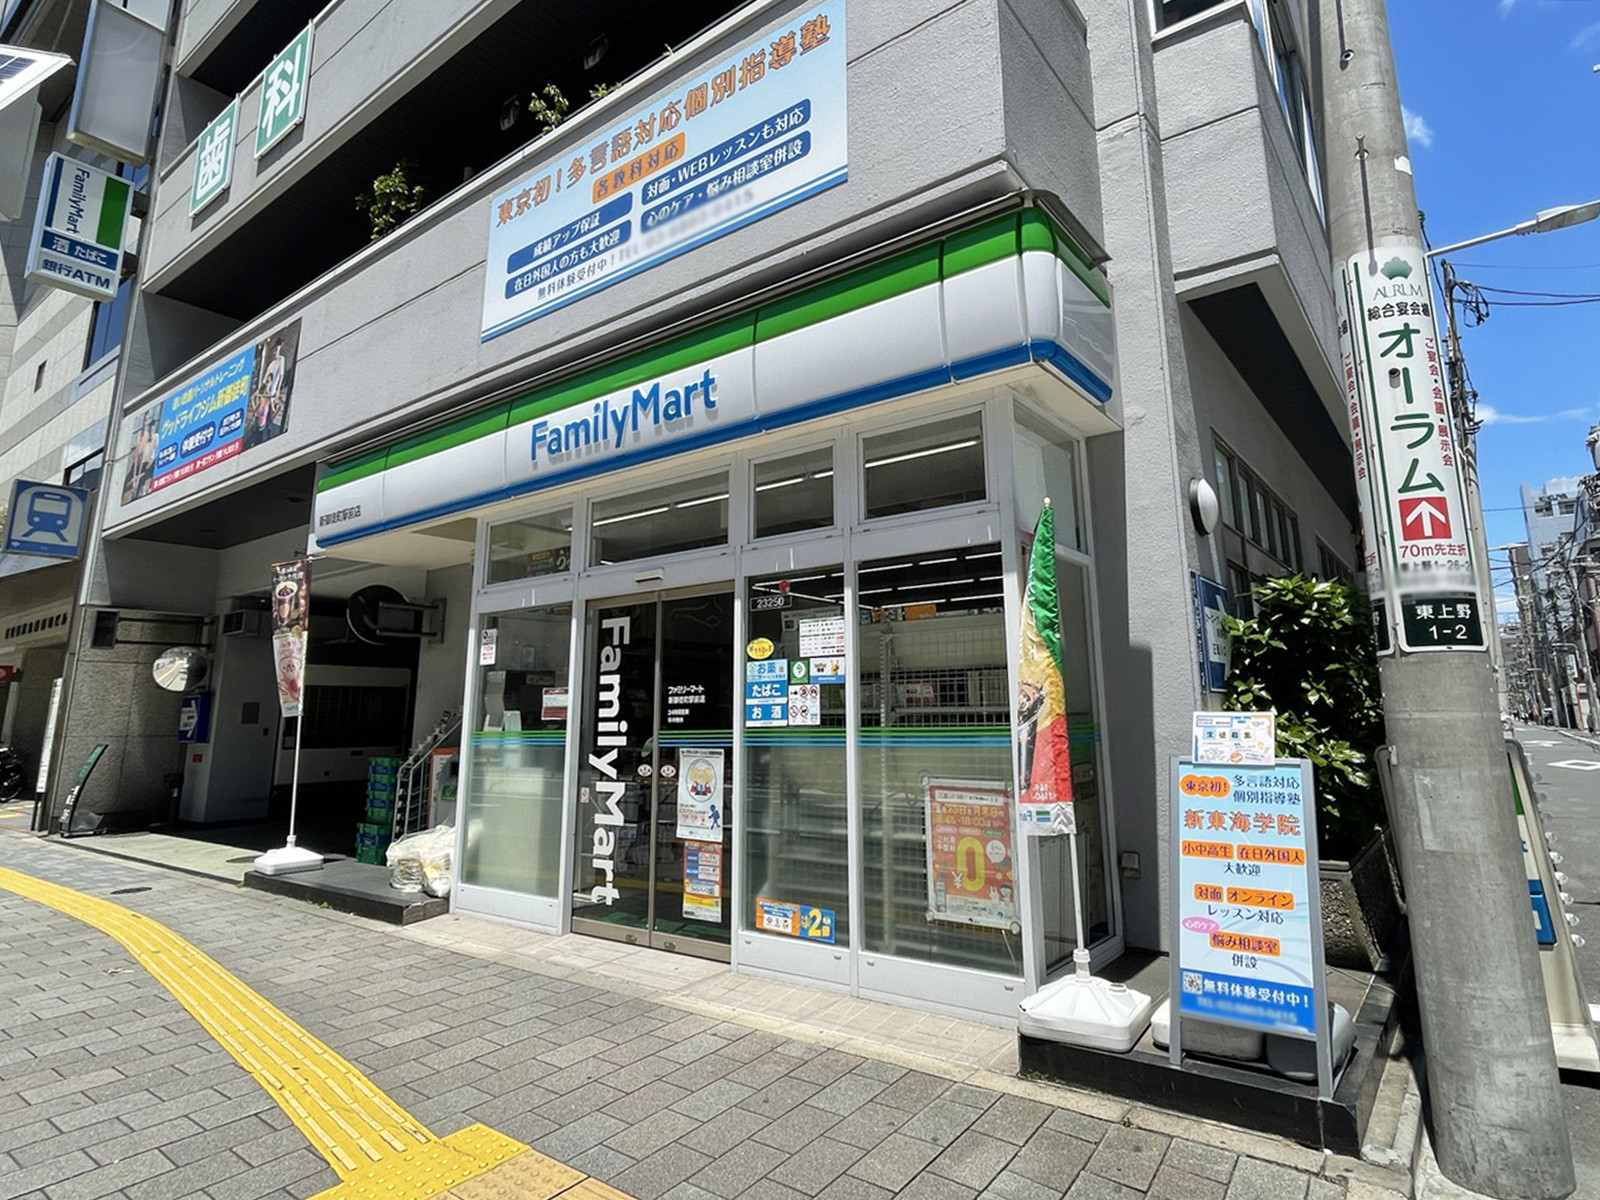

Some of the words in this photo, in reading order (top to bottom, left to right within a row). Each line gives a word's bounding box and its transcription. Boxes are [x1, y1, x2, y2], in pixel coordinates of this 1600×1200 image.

[262, 43, 302, 139] 科
[597, 141, 680, 196] 各教科対応
[66, 166, 91, 235] FamilyMart
[52, 236, 70, 255] 酒
[74, 244, 108, 266] たばこ
[42, 258, 111, 290] 銀行ATM
[1373, 282, 1425, 301] AURUM
[531, 368, 718, 461] FamilyMart
[1378, 322, 1446, 495] オーラム
[1415, 604, 1472, 620] 東上野
[1429, 624, 1468, 640] 1-2
[752, 683, 781, 697] たばこ
[588, 616, 631, 906] FamilyMart
[1233, 774, 1300, 790] 多言語対応
[1233, 791, 1301, 806] 個別指導塾
[1184, 808, 1301, 836] 新東海学院
[1183, 842, 1233, 858] 小中高生
[1239, 846, 1304, 864] 在日外国人
[1224, 861, 1261, 877] 大歓迎
[1197, 886, 1222, 900] 対面
[1228, 890, 1293, 907] オンライン
[1207, 904, 1285, 926] レッスン対応
[1212, 933, 1278, 954] 悩み相談室
[1232, 953, 1259, 970] 併設
